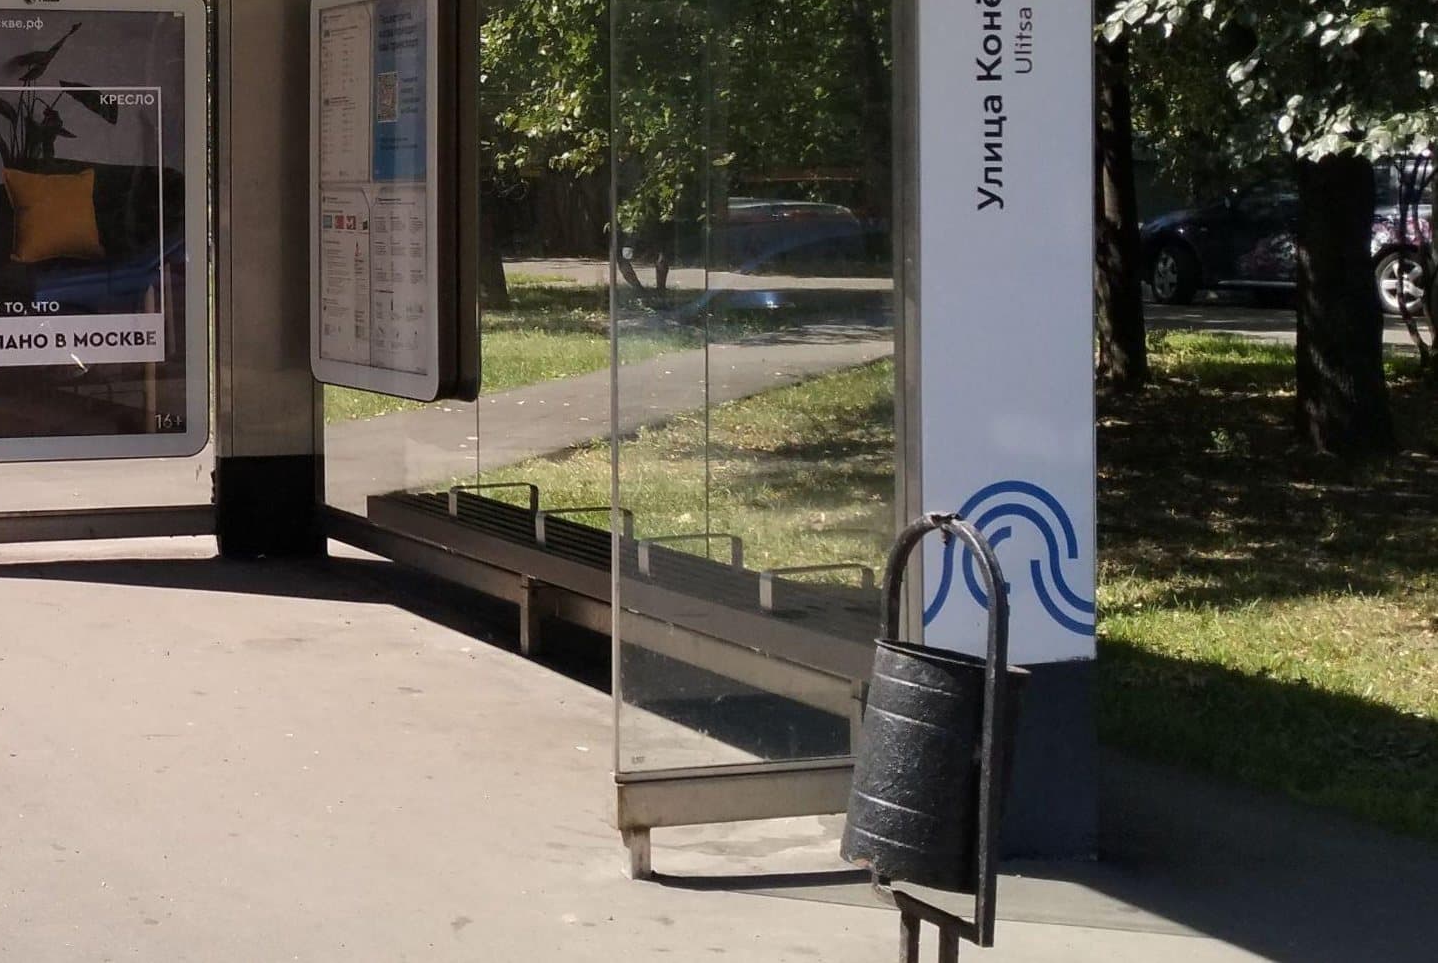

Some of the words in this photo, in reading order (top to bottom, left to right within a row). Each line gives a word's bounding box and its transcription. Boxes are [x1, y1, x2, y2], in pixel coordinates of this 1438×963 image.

[1014, 6, 1033, 75] Ulitsa
[99, 93, 155, 106] КРЕСЛО
[976, 91, 1007, 211] Улица
[4, 301, 28, 316] ТО,
[31, 300, 61, 313] ЧТО
[54, 332, 67, 347] В
[73, 330, 158, 348] МОСКВЕ
[154, 413, 183, 429] 16+
